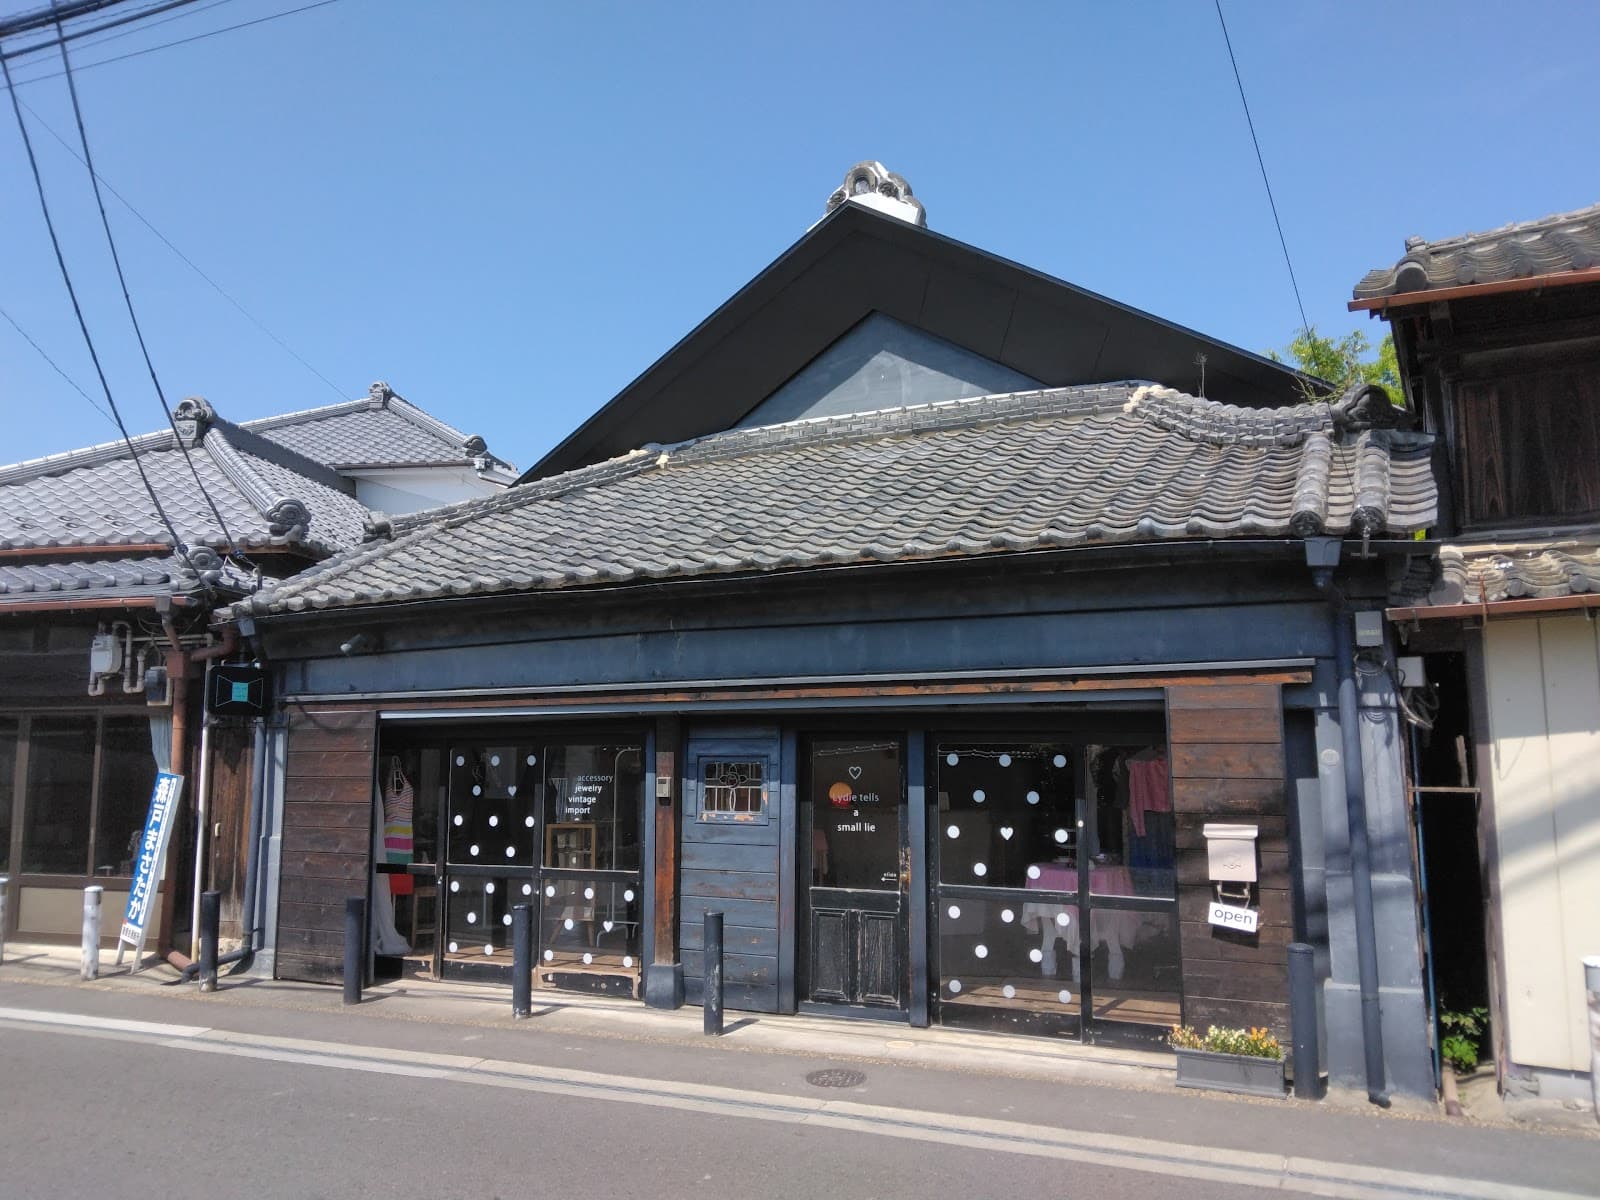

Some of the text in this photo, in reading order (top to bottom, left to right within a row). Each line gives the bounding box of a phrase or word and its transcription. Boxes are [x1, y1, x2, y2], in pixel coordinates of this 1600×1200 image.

[577, 775, 613, 783] accessory
[575, 784, 602, 793] jewelry
[568, 796, 597, 805] vintage
[832, 792, 879, 803] Lydie tells
[565, 807, 590, 815] import
[853, 809, 859, 817] a
[837, 822, 876, 832] small lie
[1215, 909, 1252, 924] open
